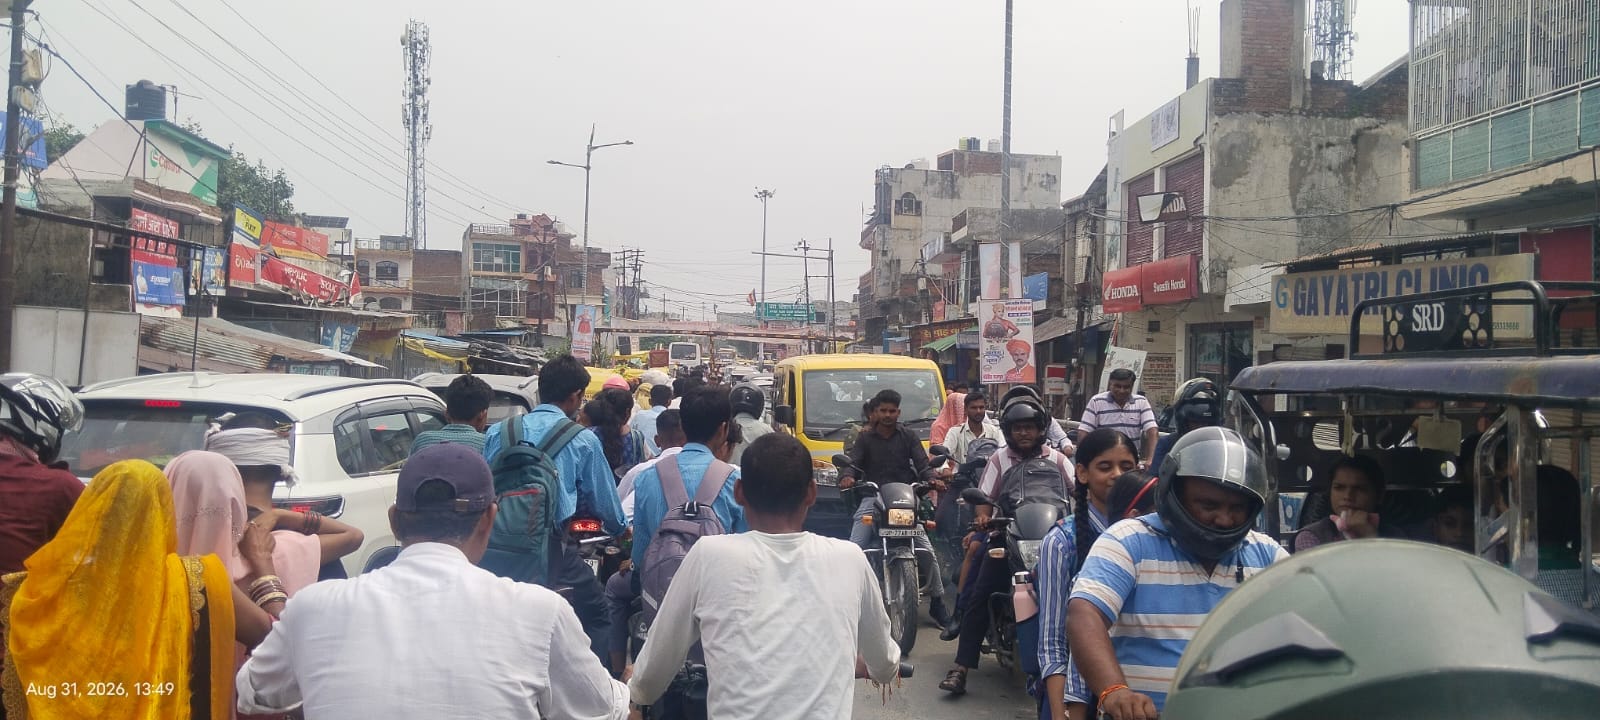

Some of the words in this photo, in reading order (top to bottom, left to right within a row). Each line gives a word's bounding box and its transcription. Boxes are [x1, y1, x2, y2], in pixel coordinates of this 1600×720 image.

[1111, 284, 1139, 300] HONDA
[1170, 277, 1186, 291] Honda
[1293, 271, 1388, 316] GAYATRI
[1412, 302, 1445, 332] SRD
